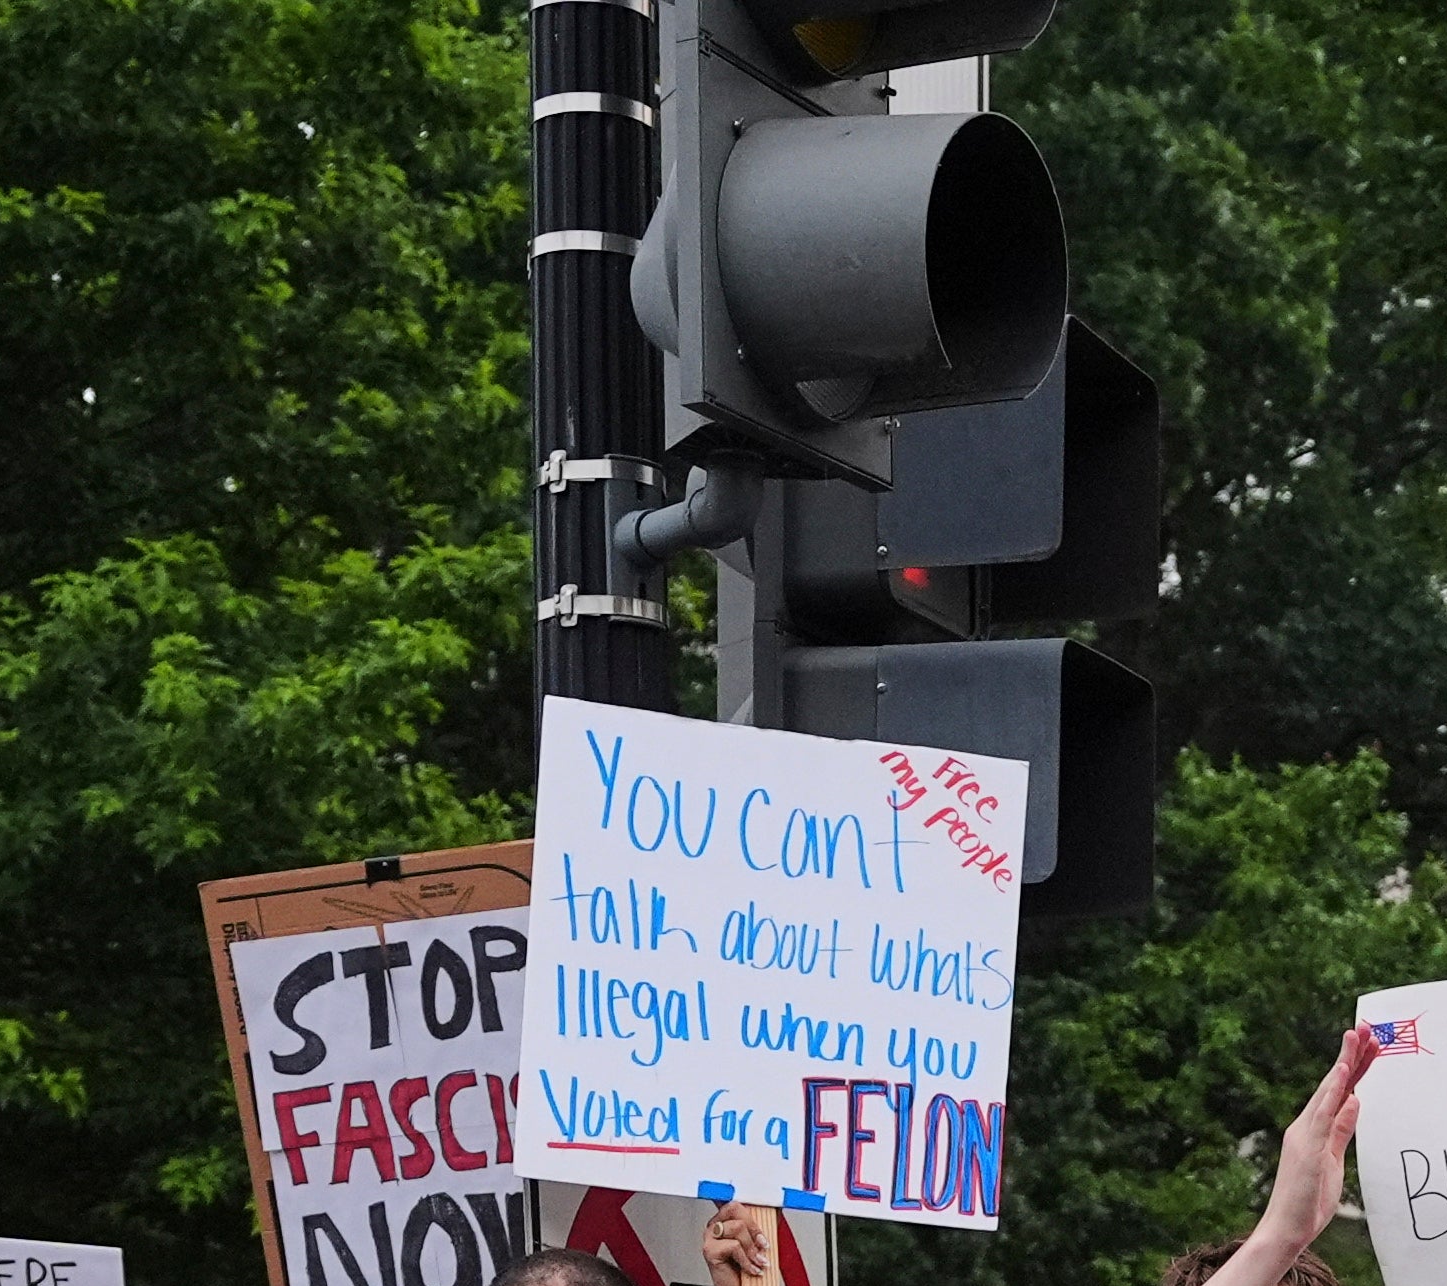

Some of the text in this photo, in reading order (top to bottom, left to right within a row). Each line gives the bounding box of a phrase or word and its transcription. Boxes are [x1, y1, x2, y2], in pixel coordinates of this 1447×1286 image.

[930, 755, 1002, 825] Free
[920, 799, 1017, 895] people
[551, 853, 698, 956] talk
[720, 900, 854, 980] about
[269, 925, 527, 1077] STOP
[741, 1002, 864, 1068] when
[887, 1027, 978, 1089] you
[540, 1068, 681, 1142] Voted
[762, 1117, 790, 1160] a
[801, 1077, 1008, 1217] FELON
